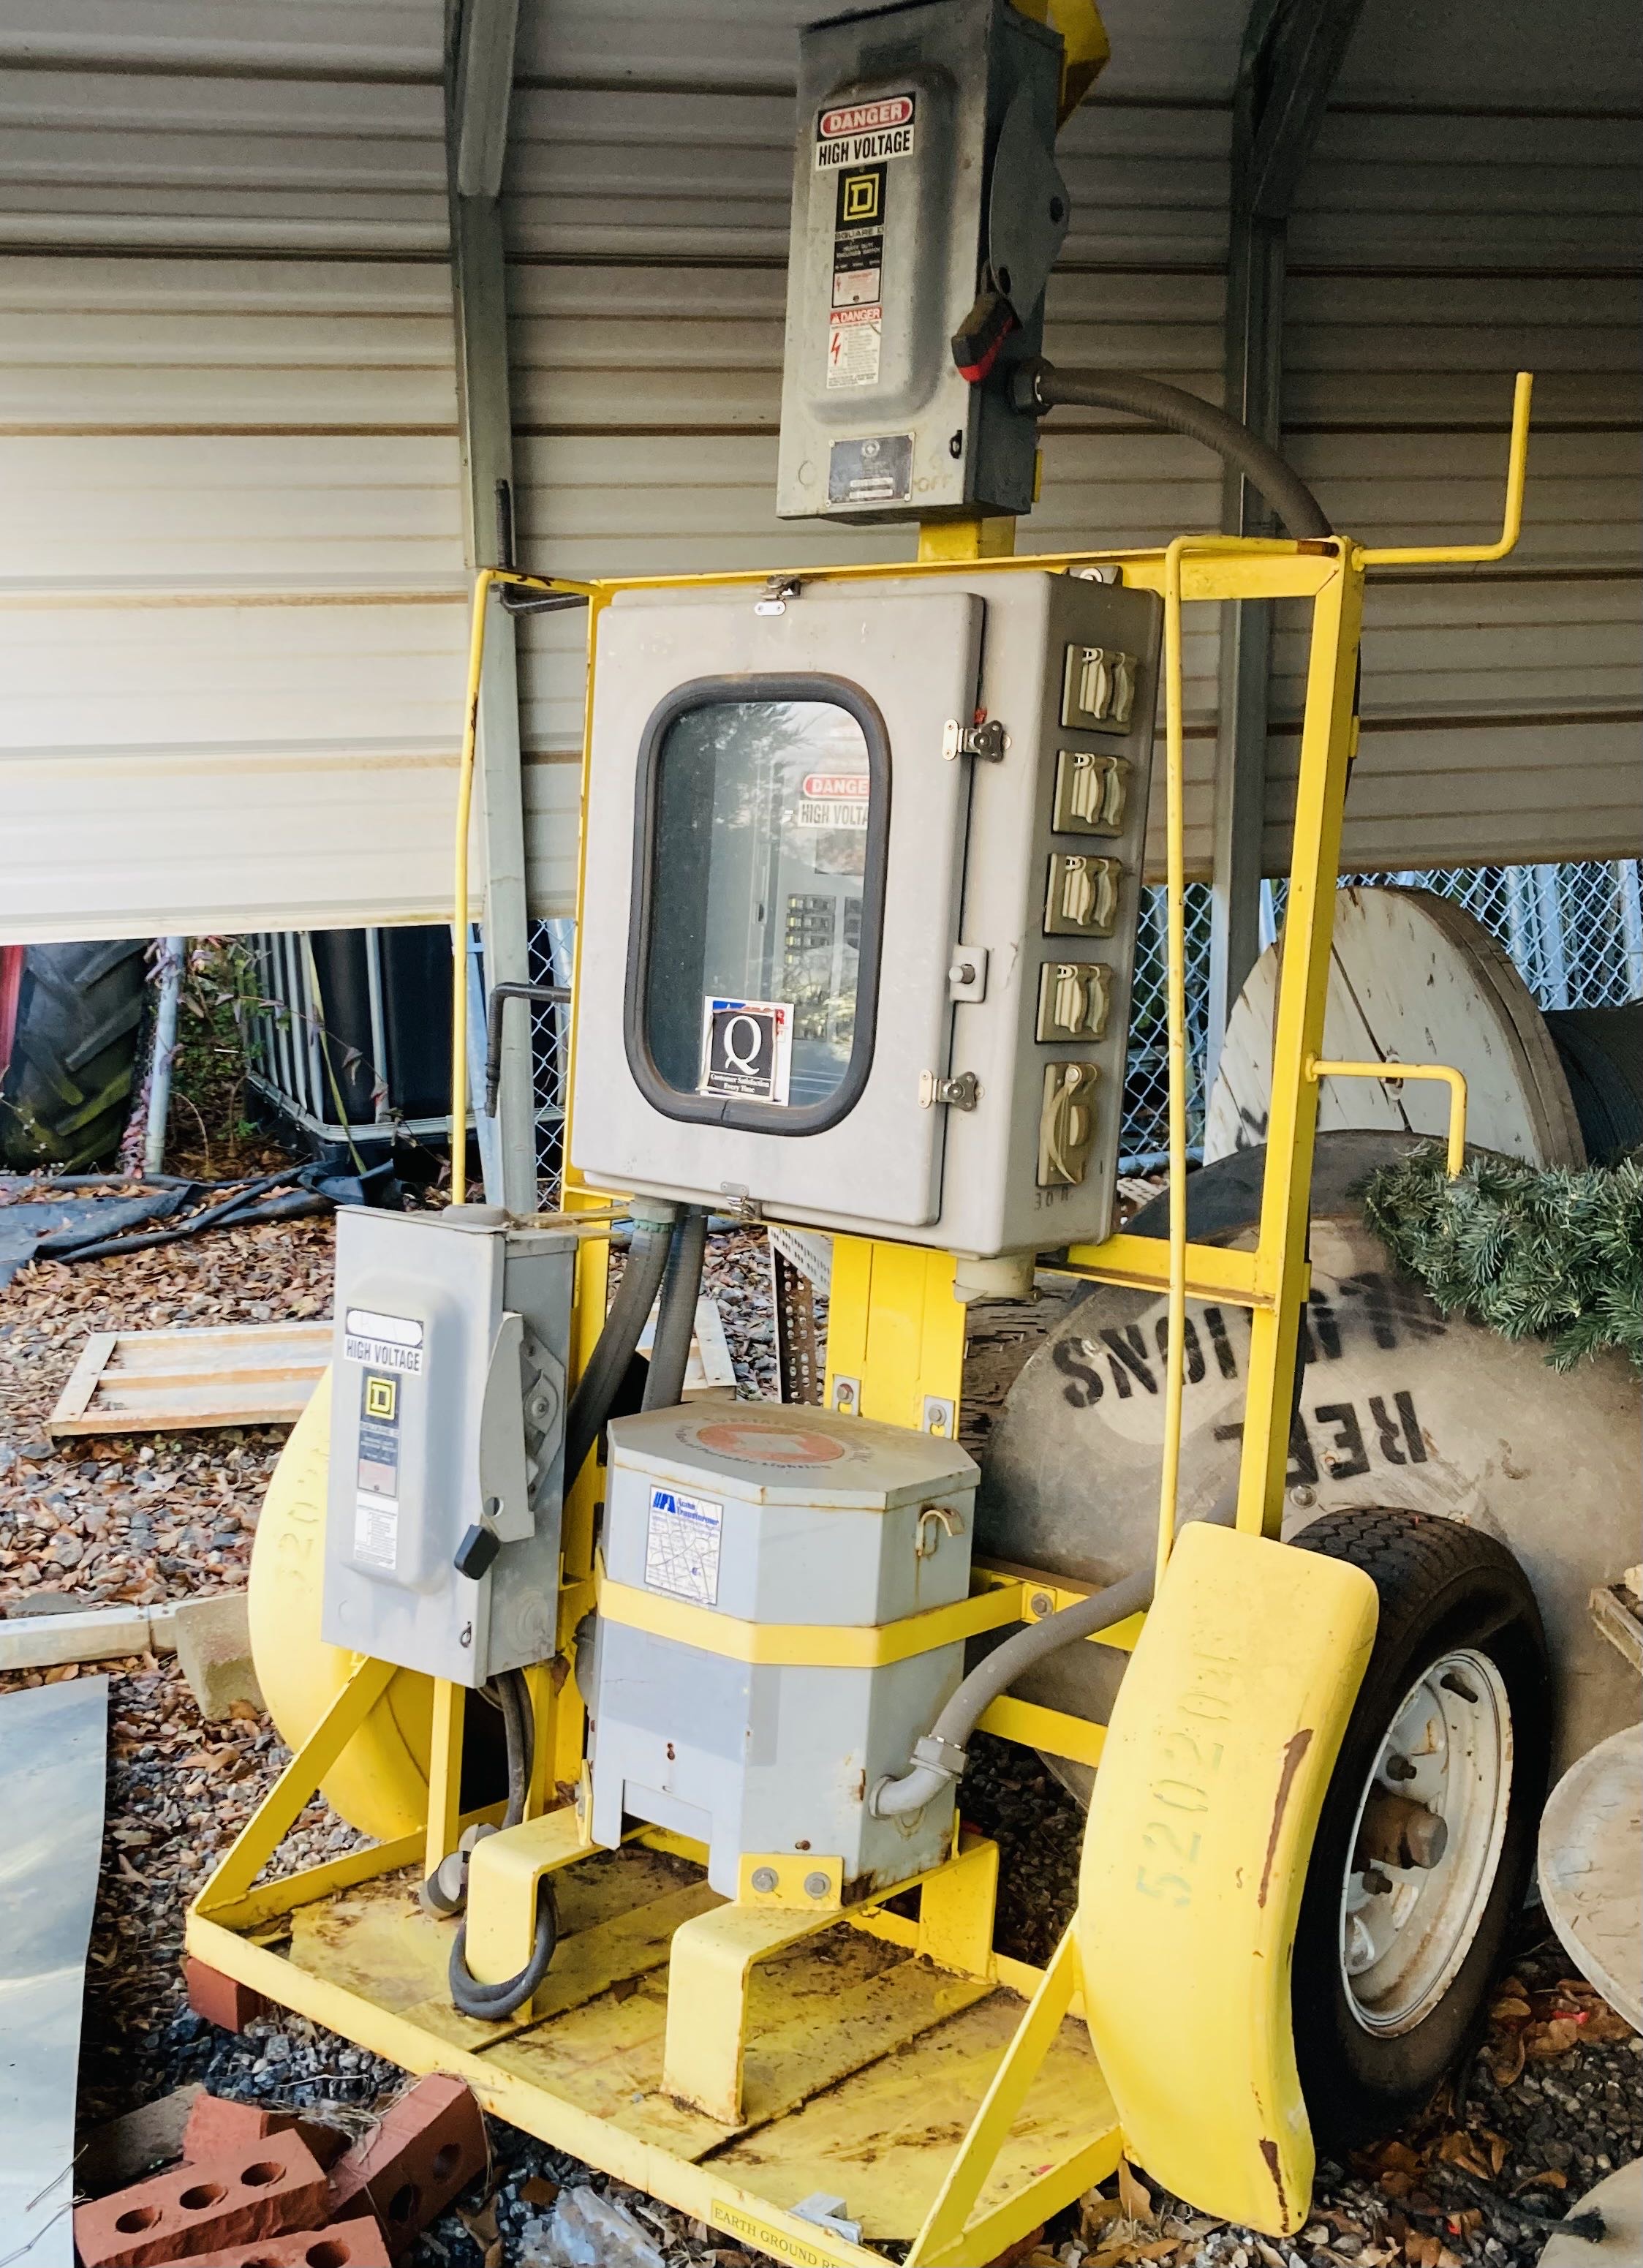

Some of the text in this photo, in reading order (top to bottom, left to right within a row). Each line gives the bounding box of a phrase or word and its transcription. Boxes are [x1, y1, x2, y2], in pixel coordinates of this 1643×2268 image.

[829, 102, 903, 132] DANGER
[818, 129, 911, 166] HIGH VOLTAGE
[849, 181, 873, 213] D
[840, 308, 880, 322] DANGER
[812, 777, 869, 794] DANGE
[801, 804, 869, 825] HIGH VOLTA
[723, 1015, 762, 1076] Q
[724, 1082, 755, 1093] Every Time
[738, 1077, 770, 1088] Satisfaction
[346, 1338, 420, 1371] HIGH VOLTAGE
[714, 2207, 757, 2237] EARTH
[760, 2229, 818, 2266] GROUND
